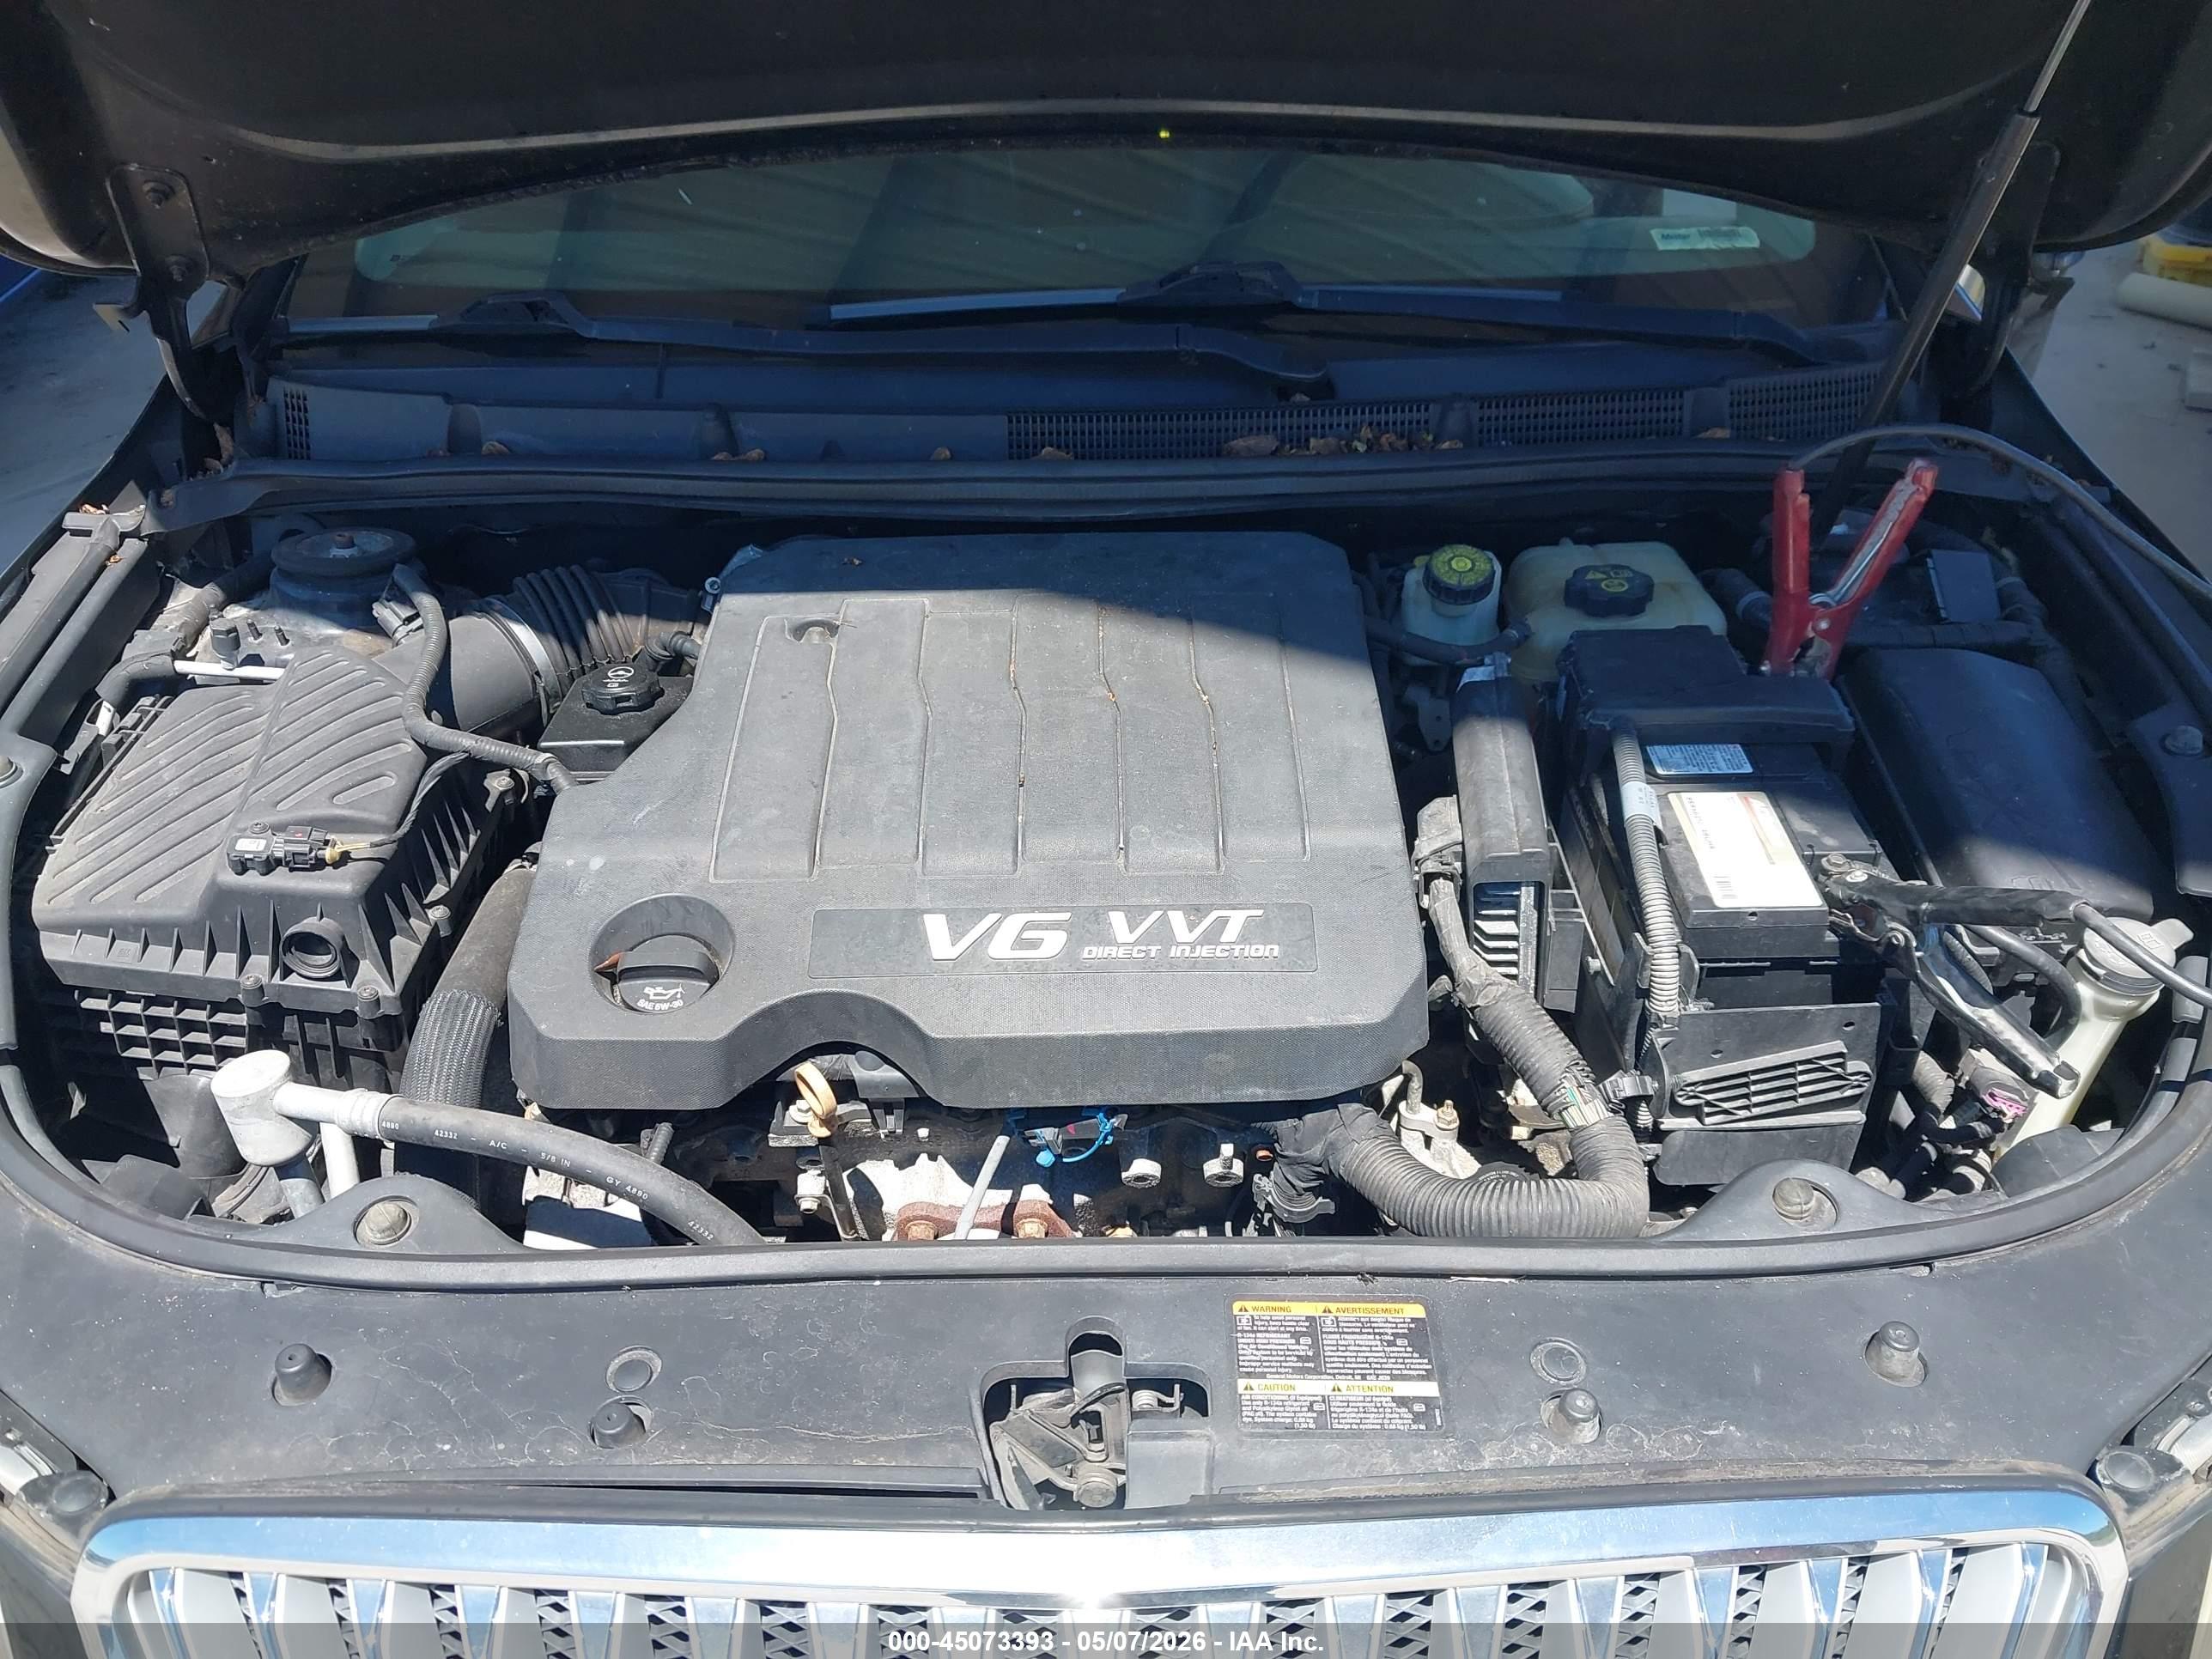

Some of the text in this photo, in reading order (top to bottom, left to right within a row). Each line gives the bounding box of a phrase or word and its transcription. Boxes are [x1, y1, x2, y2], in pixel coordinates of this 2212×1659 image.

[923, 909, 1265, 962] V6 VVT
[1082, 944, 1280, 961] DIRECT INJECTION
[434, 1129, 459, 1140] 42332
[489, 1139, 508, 1151] A/C
[539, 1152, 558, 1163] 5/8
[561, 1158, 572, 1168] IN
[605, 1176, 622, 1188] GY
[625, 1185, 649, 1200] 4890
[687, 1220, 714, 1241] 42332
[1346, 1384, 1394, 1393] ATTENTION
